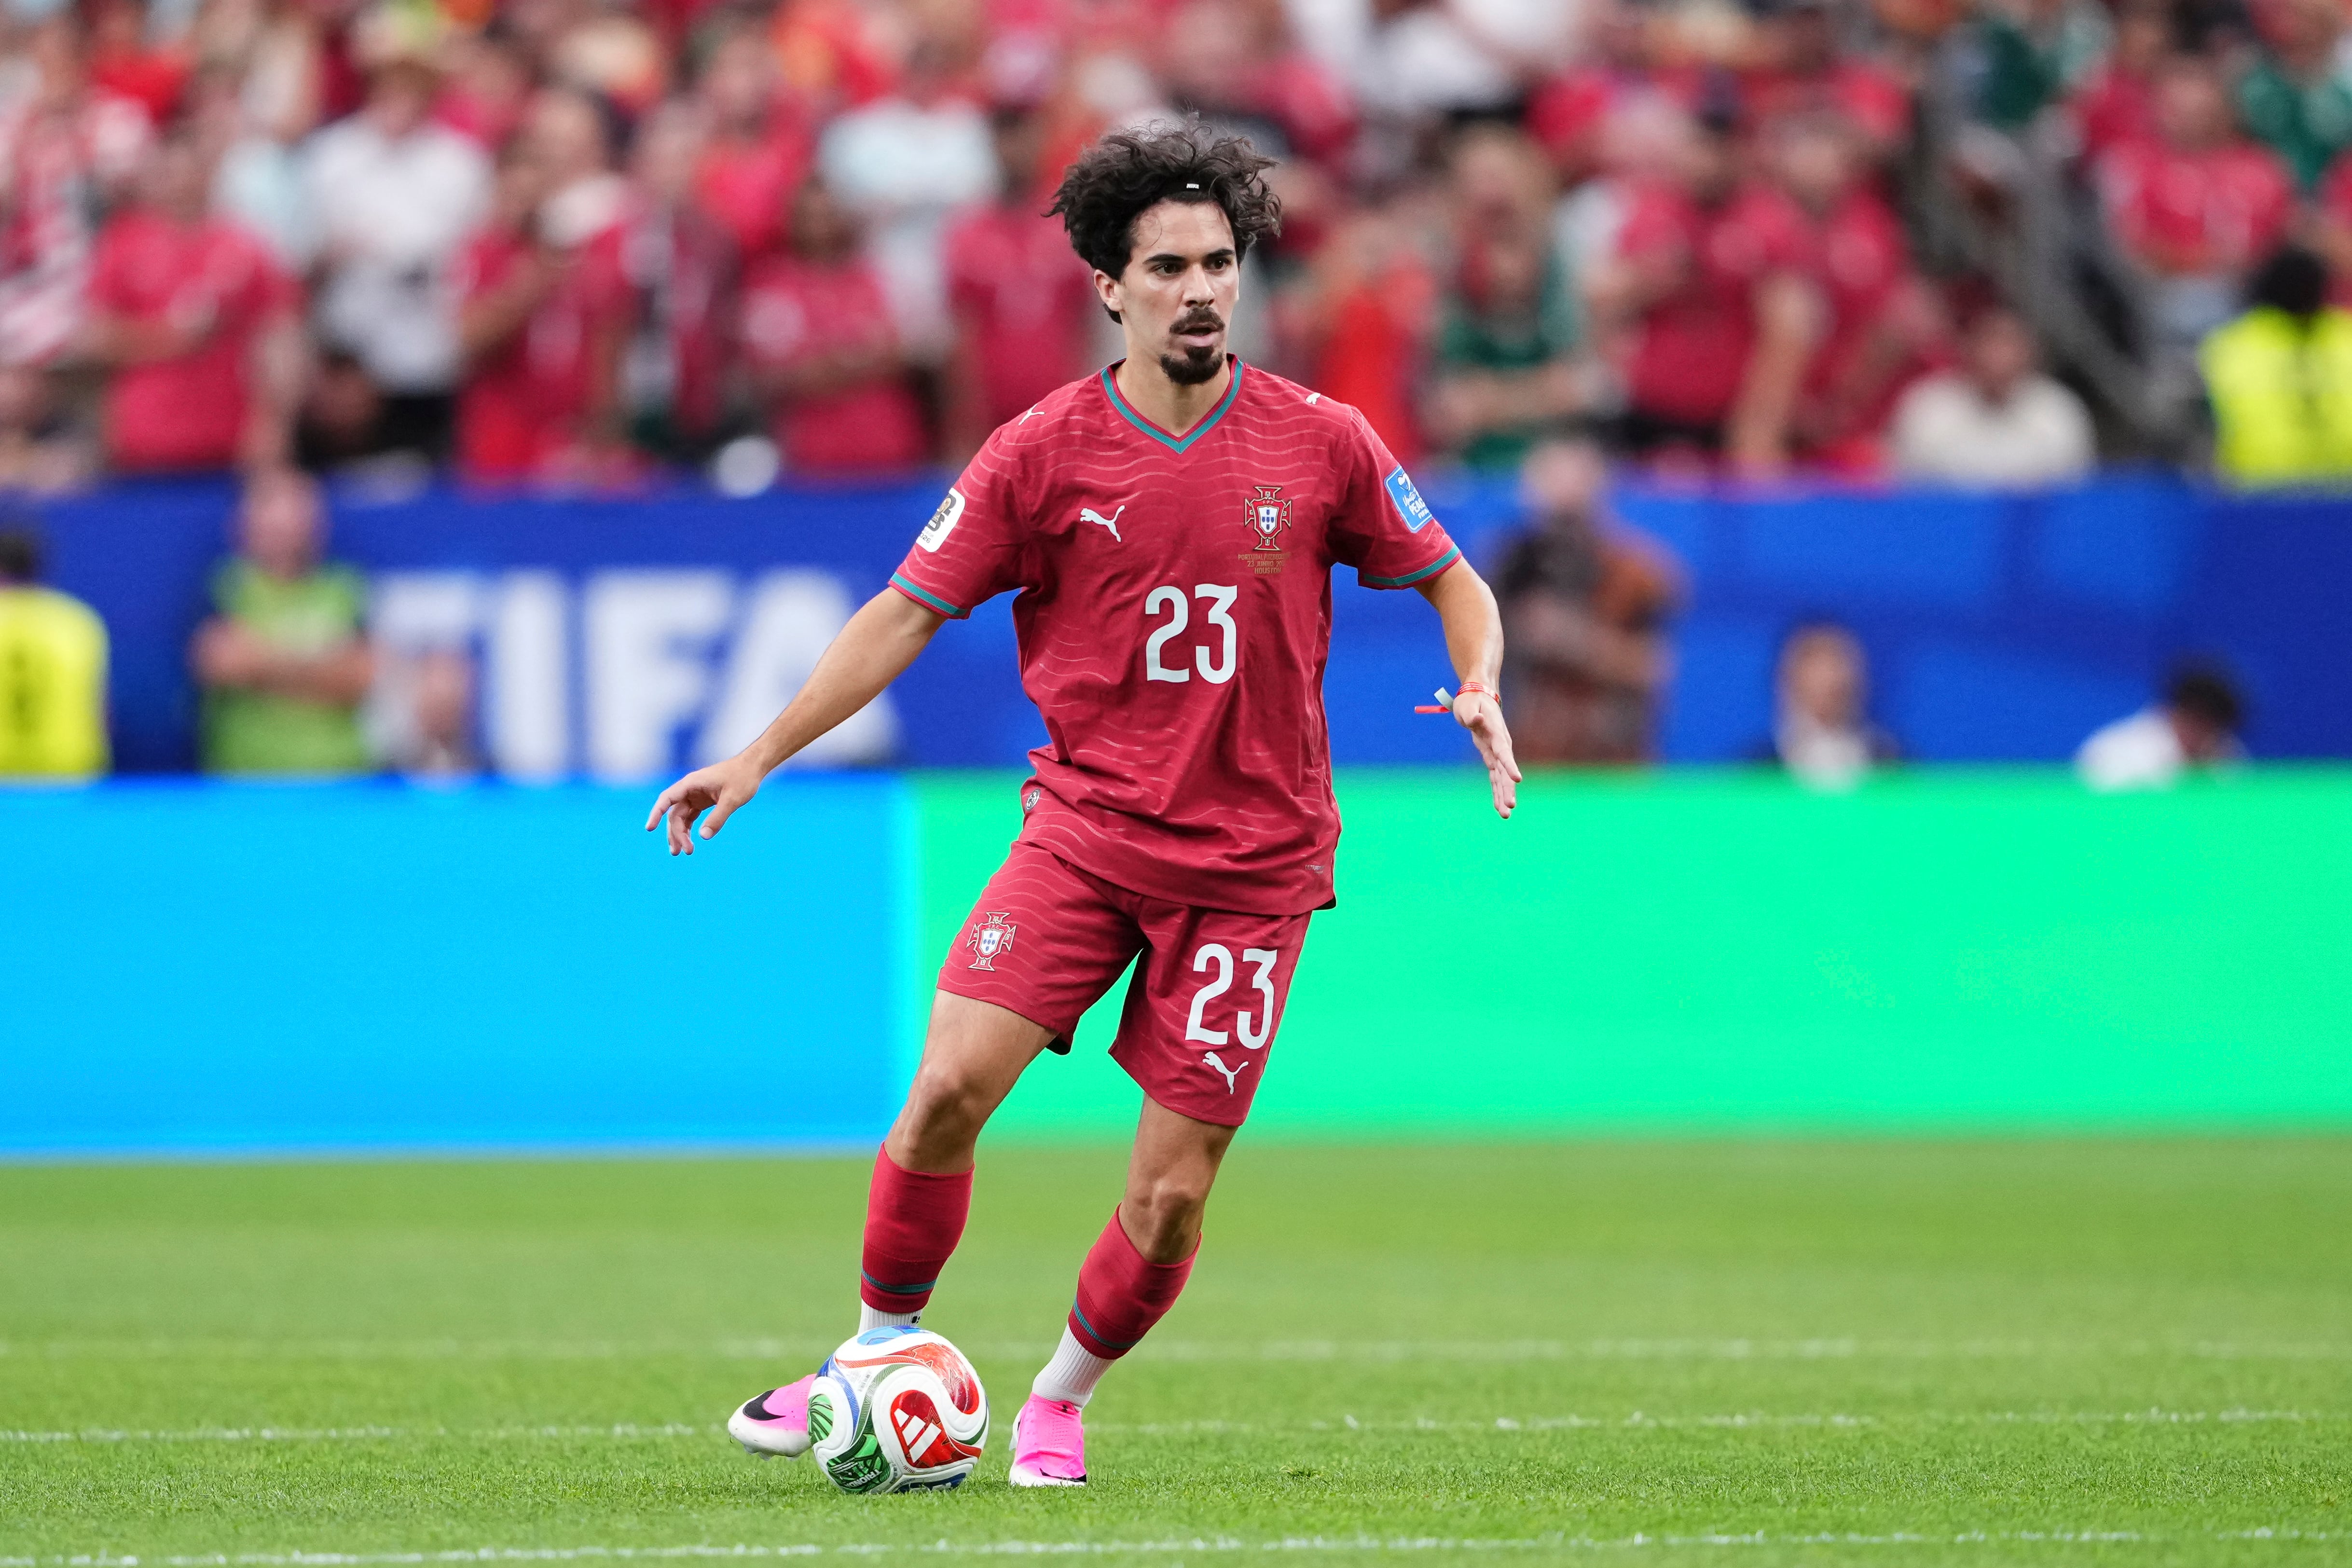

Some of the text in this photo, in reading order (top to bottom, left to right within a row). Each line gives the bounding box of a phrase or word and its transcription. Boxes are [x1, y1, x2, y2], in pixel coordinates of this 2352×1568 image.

[1409, 497, 1426, 515] PEAC
[920, 533, 931, 543] 026
[1145, 583, 1238, 684] 23
[1185, 943, 1278, 1049] 23
